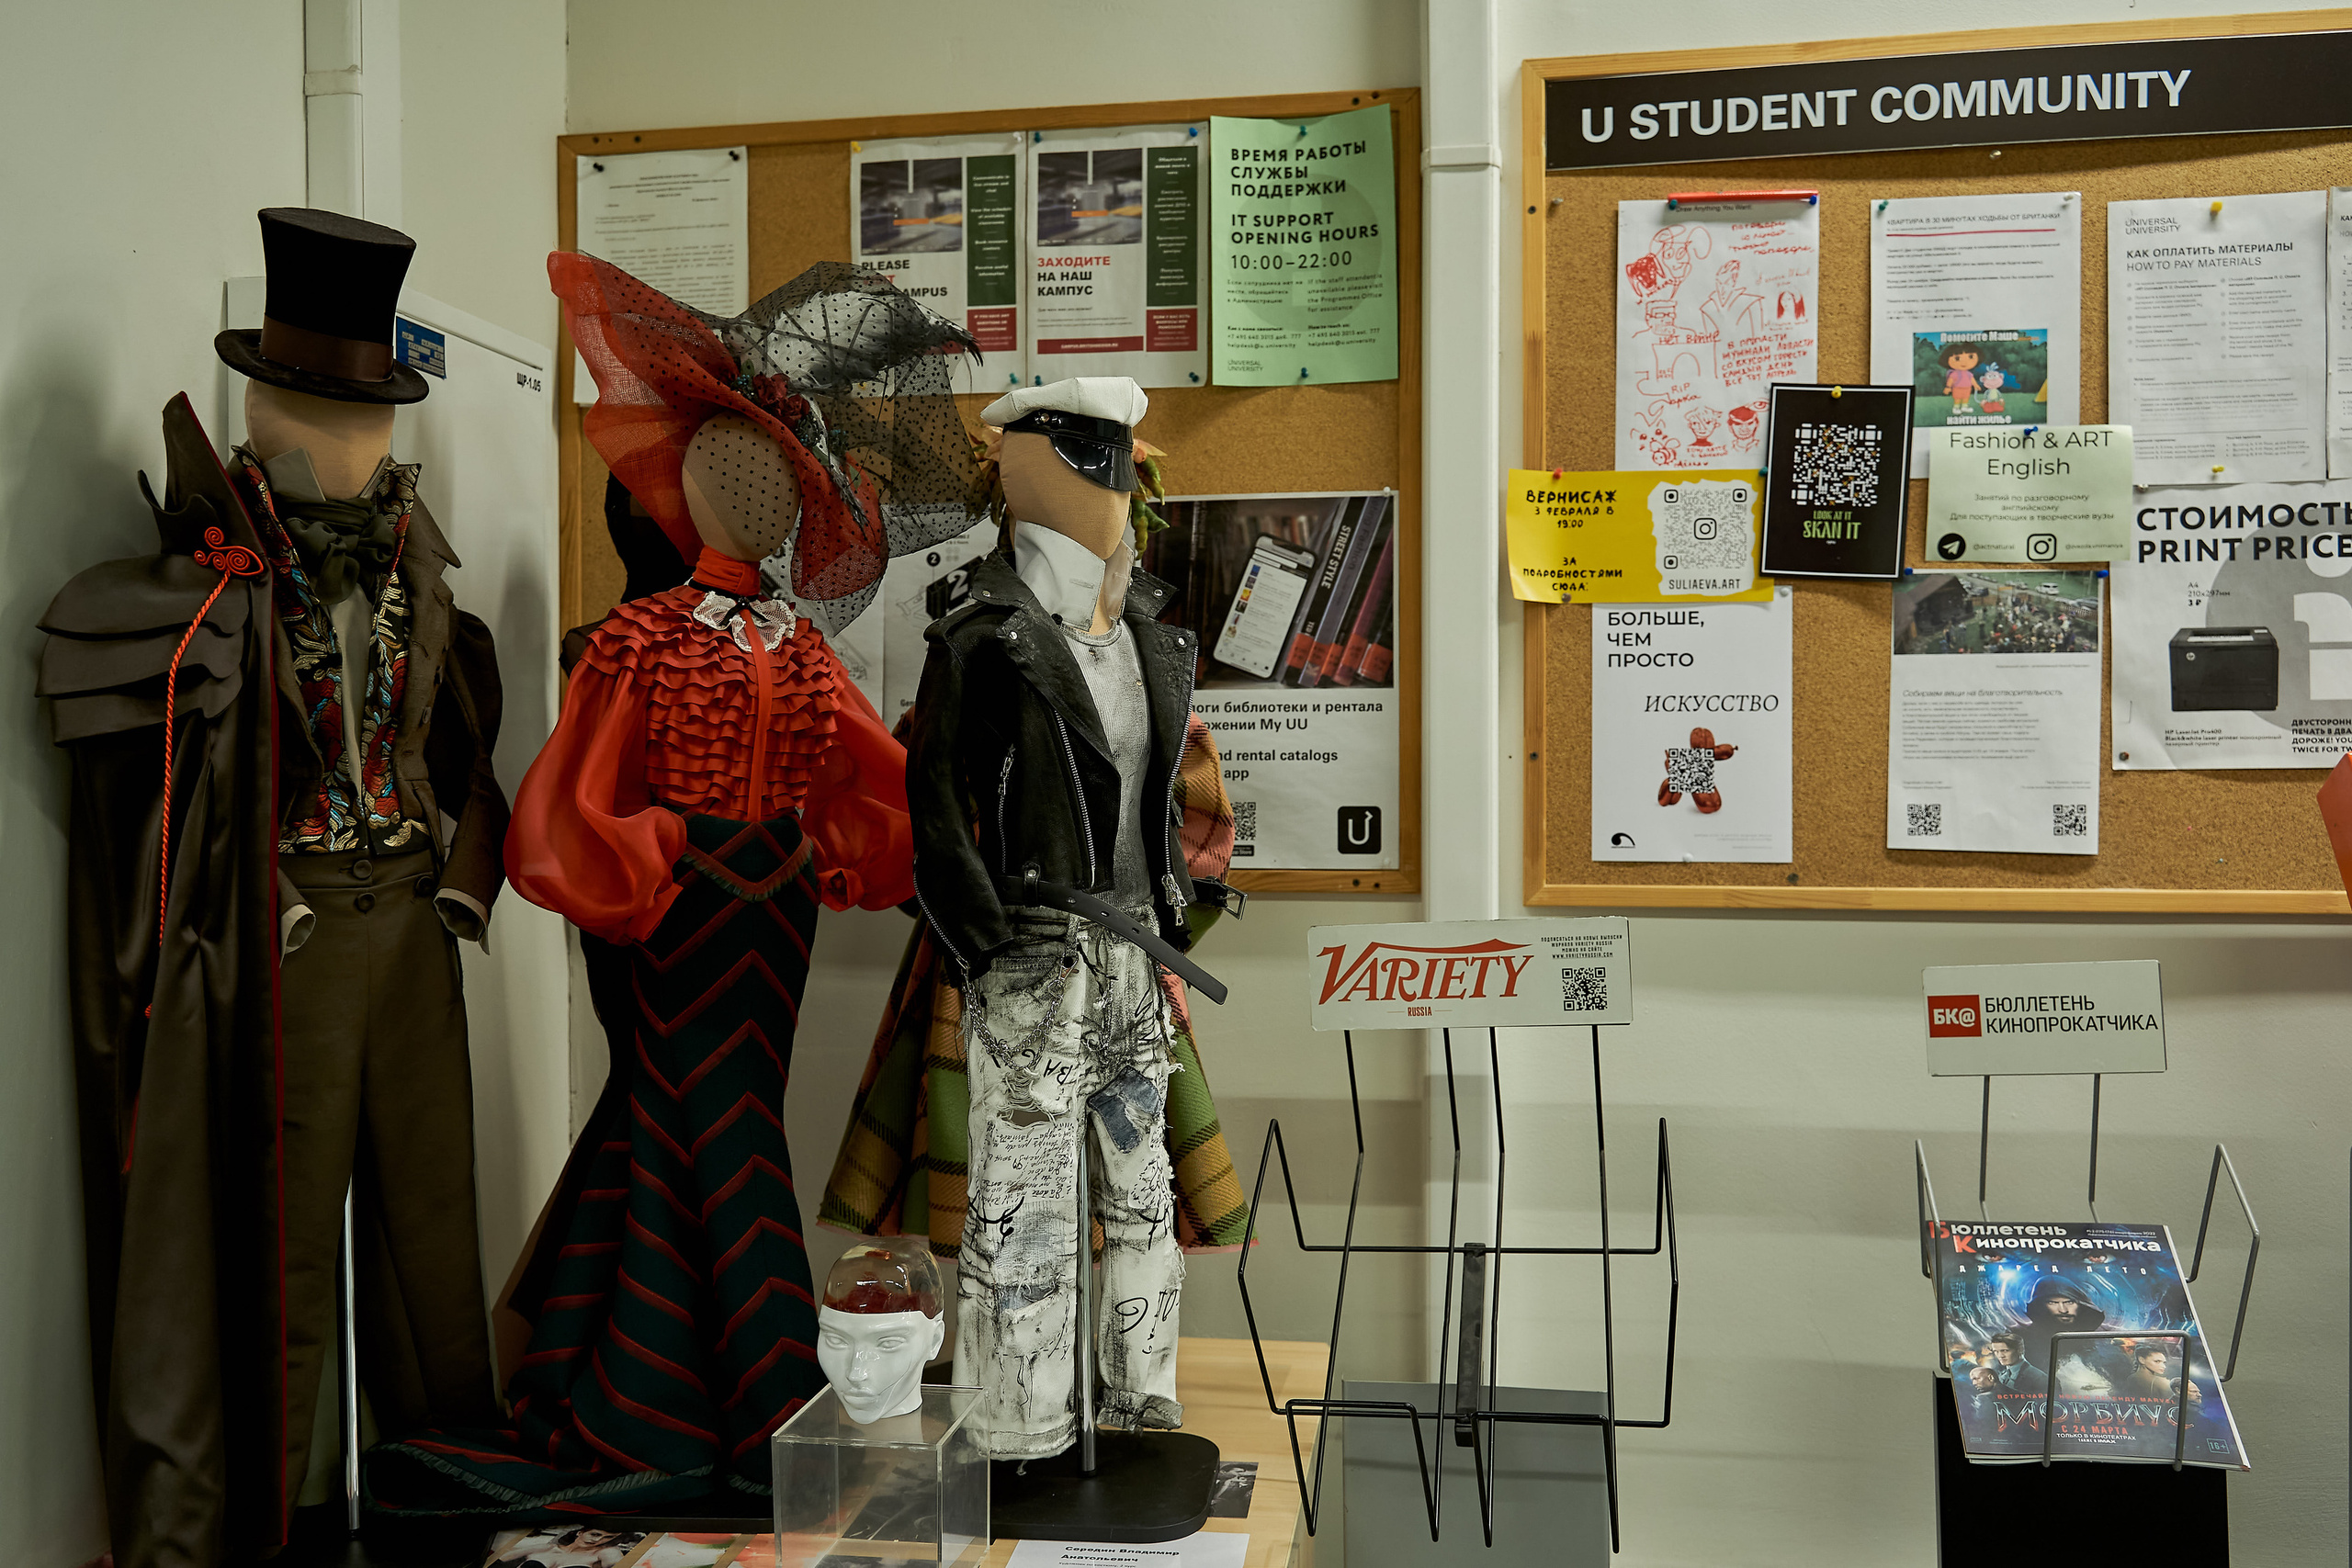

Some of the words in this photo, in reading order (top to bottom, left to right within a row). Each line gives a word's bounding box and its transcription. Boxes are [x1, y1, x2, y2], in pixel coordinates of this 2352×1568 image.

[1582, 108, 1613, 143] U
[1630, 89, 1857, 141] STUDENT
[1870, 70, 2191, 123] COMMUNITY
[1231, 149, 1287, 162] ВРЕМЯ
[1295, 141, 1366, 161] РАБОТЫ
[1231, 166, 1307, 179] СЛУЖБЫ
[1231, 180, 1346, 198] ПОДДЕРЖКИ
[1232, 214, 1247, 227] IT
[1254, 212, 1334, 227] SUPPORT
[2125, 218, 2177, 227] UNIVERSAL
[1232, 231, 1312, 244] OPENING
[1319, 225, 1378, 243] HOURS
[2125, 225, 2180, 234] UNIVERSITY
[2127, 250, 2149, 258] КАК
[2153, 247, 2214, 257] ОПЛАТИТЬ
[2219, 243, 2293, 254] МАТЕРИАЛЫ
[862, 260, 910, 270] PLEASE
[1037, 255, 1111, 267] ЗАХОДИТЕ
[2127, 263, 2154, 271] HOW
[2198, 257, 2262, 267] MATERIALS
[1038, 272, 1056, 282] НА
[1060, 271, 1091, 281] НАШ
[902, 287, 947, 297] AMPUS
[1037, 286, 1092, 297] КАМПУС
[1940, 332, 1987, 343] Помогите
[1989, 332, 2018, 342] Маше
[516, 372, 541, 392] ЩР-1.05
[1947, 415, 1977, 425] найти
[1950, 432, 2034, 449] Fashion
[2043, 433, 2058, 448] &
[2065, 431, 2113, 447] ART
[1987, 458, 2070, 479] English
[1526, 491, 1617, 503] ВЕРНИСАЖ
[2024, 494, 2089, 502] разговорному
[1546, 506, 1599, 515] ФЕВРАЛЯ
[1814, 511, 1832, 520] LOOK
[1833, 511, 1842, 520] AT
[1845, 512, 1852, 520] IT
[1803, 520, 1841, 538] SKAN
[1847, 522, 1861, 539] IT
[1332, 525, 1351, 561] STREET
[2139, 538, 2242, 563] PRINT
[930, 553, 938, 564] 2
[1563, 558, 1577, 566] ЗА
[1321, 558, 1339, 589] STYLE
[1523, 569, 1623, 578] ПОДРОБНОСТЯМИ
[947, 570, 968, 601] 2
[1668, 579, 1741, 590] SULIAEVA.ART
[1608, 611, 1704, 626] БОЛЬШЕ,
[1608, 633, 1651, 647] ЧЕМ
[1609, 653, 1694, 667] ПРОСТО
[1225, 702, 1307, 713] библиотеки
[1326, 703, 1383, 715] рентала
[1645, 694, 1779, 713] ИСКУССТВО
[1261, 718, 1282, 732] My
[1286, 718, 1307, 729] UU
[1237, 750, 1275, 761] rental
[1280, 750, 1338, 763] catalogs
[1224, 770, 1249, 781] app
[1317, 938, 1534, 1005] VARIETY
[1408, 1007, 1431, 1017] RUSSIA
[1934, 1008, 1975, 1028] БК@
[1984, 996, 2095, 1012] БЮЛЛЕТЕНЬ
[1986, 1014, 2158, 1033] КИНОПРОКАТЧИКА
[1928, 1221, 2067, 1238] Бюллетень
[1953, 1235, 2161, 1253] Кинопрокатчика
[1960, 1265, 2058, 1273] ДЖАРЕД
[2087, 1266, 2146, 1275] ЛЕТО
[1993, 1401, 2194, 1432] МОРБИУС
[2073, 1426, 2086, 1434] 24
[2092, 1427, 2129, 1435] МАРТА
[2209, 1441, 2227, 1450] 16+
[1061, 1554, 1138, 1562] Анатольевич
[1119, 1548, 1180, 1556] Владимир
